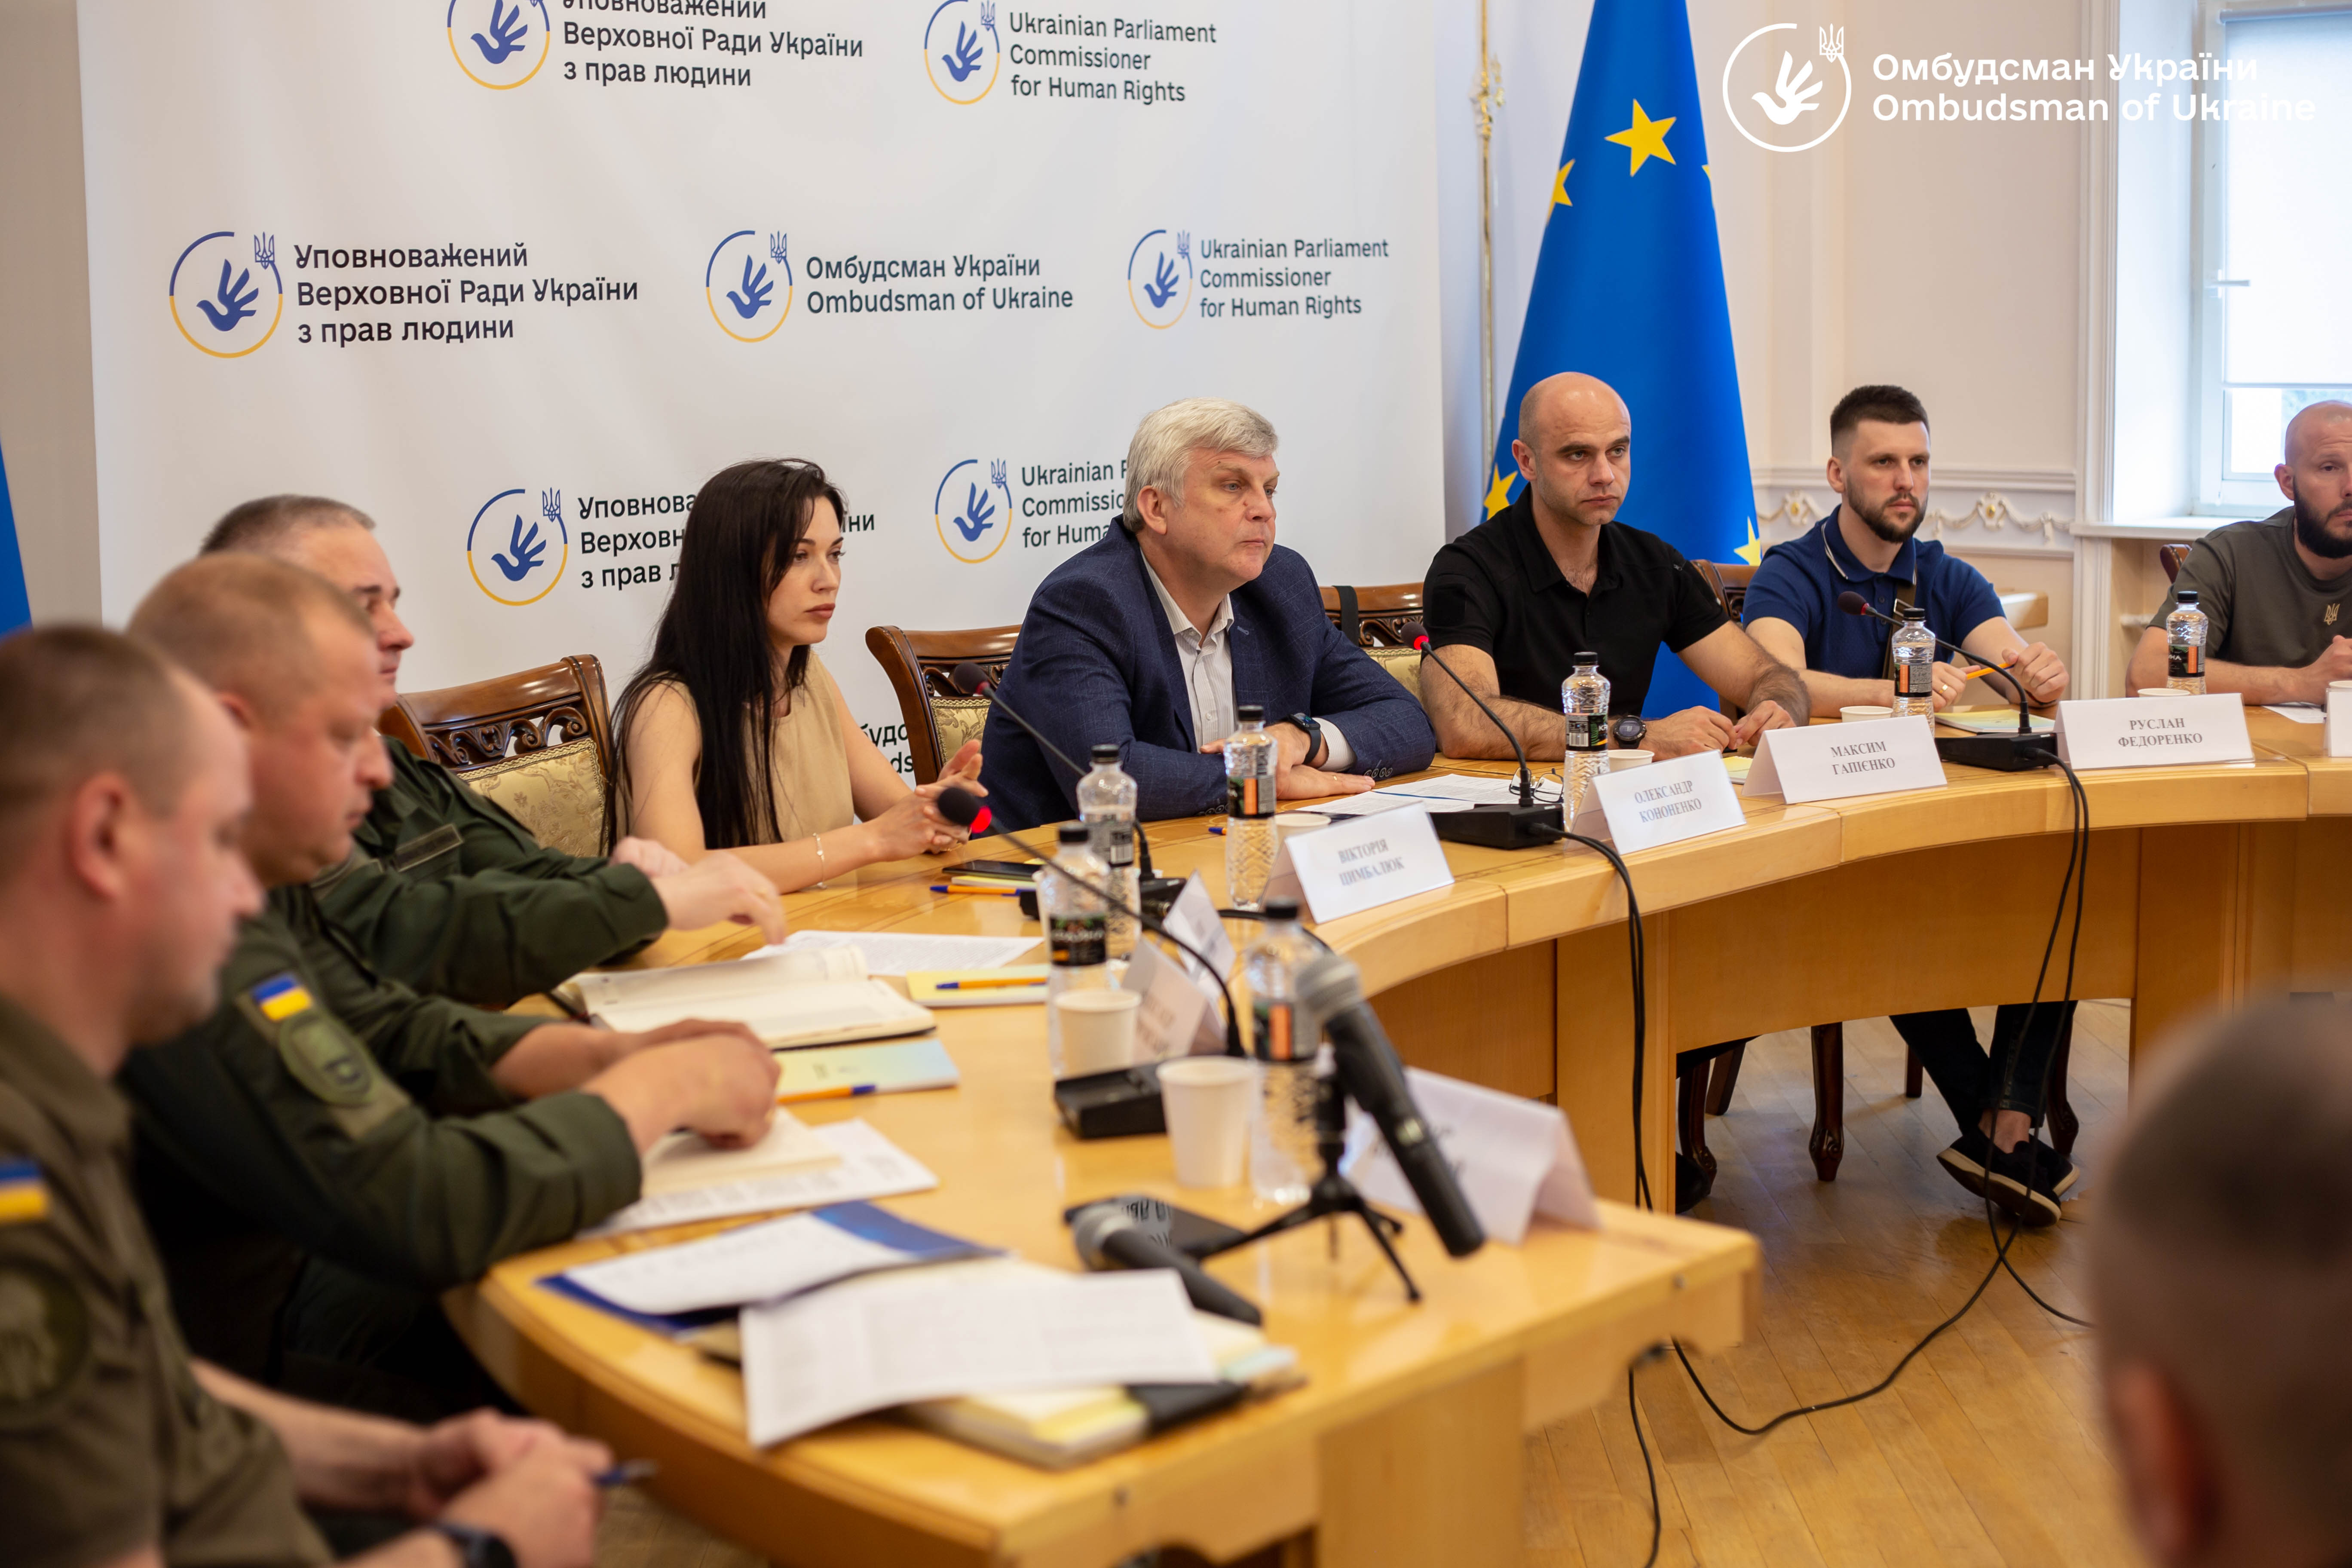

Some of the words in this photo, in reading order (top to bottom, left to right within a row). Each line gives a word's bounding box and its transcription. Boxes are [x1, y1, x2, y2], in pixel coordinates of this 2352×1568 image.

[564, 21, 694, 51] Верховної
[702, 28, 761, 56] Ради
[769, 31, 862, 60] України
[1010, 12, 1106, 37] Ukrainian
[1114, 18, 1216, 43] Parliament
[1010, 44, 1151, 70] Commissioner
[564, 61, 576, 80] з
[586, 62, 646, 86] прав
[654, 65, 750, 88] людини
[1011, 74, 1041, 96] for
[1049, 77, 1117, 99] Human
[1124, 80, 1185, 105] Rights
[294, 242, 527, 269] Уповноважений
[1201, 239, 1287, 258] Ukrainian
[1295, 239, 1388, 257] Parliament
[806, 255, 945, 284] Омбудсман
[953, 254, 1040, 282] України
[1200, 267, 1331, 288] Commissioner
[297, 279, 451, 311] Верховної
[460, 280, 524, 306] Ради
[532, 277, 637, 306] України
[807, 289, 955, 314] Ombudsman
[963, 287, 986, 310] of
[993, 286, 1073, 309] Ukraine
[1200, 298, 1225, 317] for
[1232, 298, 1298, 316] Human
[1306, 295, 1361, 319] Rights
[298, 324, 312, 343] з
[322, 322, 392, 348] прав
[402, 320, 513, 343] людини
[1022, 461, 1113, 487] Ukrainian
[578, 494, 696, 520] Уповнова
[1022, 490, 1124, 517] Commissio
[581, 529, 685, 557] Верховн
[1022, 527, 1051, 548] for
[581, 570, 593, 588] з
[602, 565, 661, 591] прав
[2130, 718, 2184, 730] РУСЛАН
[1830, 741, 1886, 757] МАКСИМ
[2118, 733, 2202, 747] ФЕДОРЕНКО
[1832, 757, 1895, 775] ГАПІЄНКО
[1635, 781, 1693, 803] ОЛЕКСАНДР
[1639, 798, 1701, 822] КОНОНЕНКО
[1338, 839, 1389, 863] ВІКТОРІЯ
